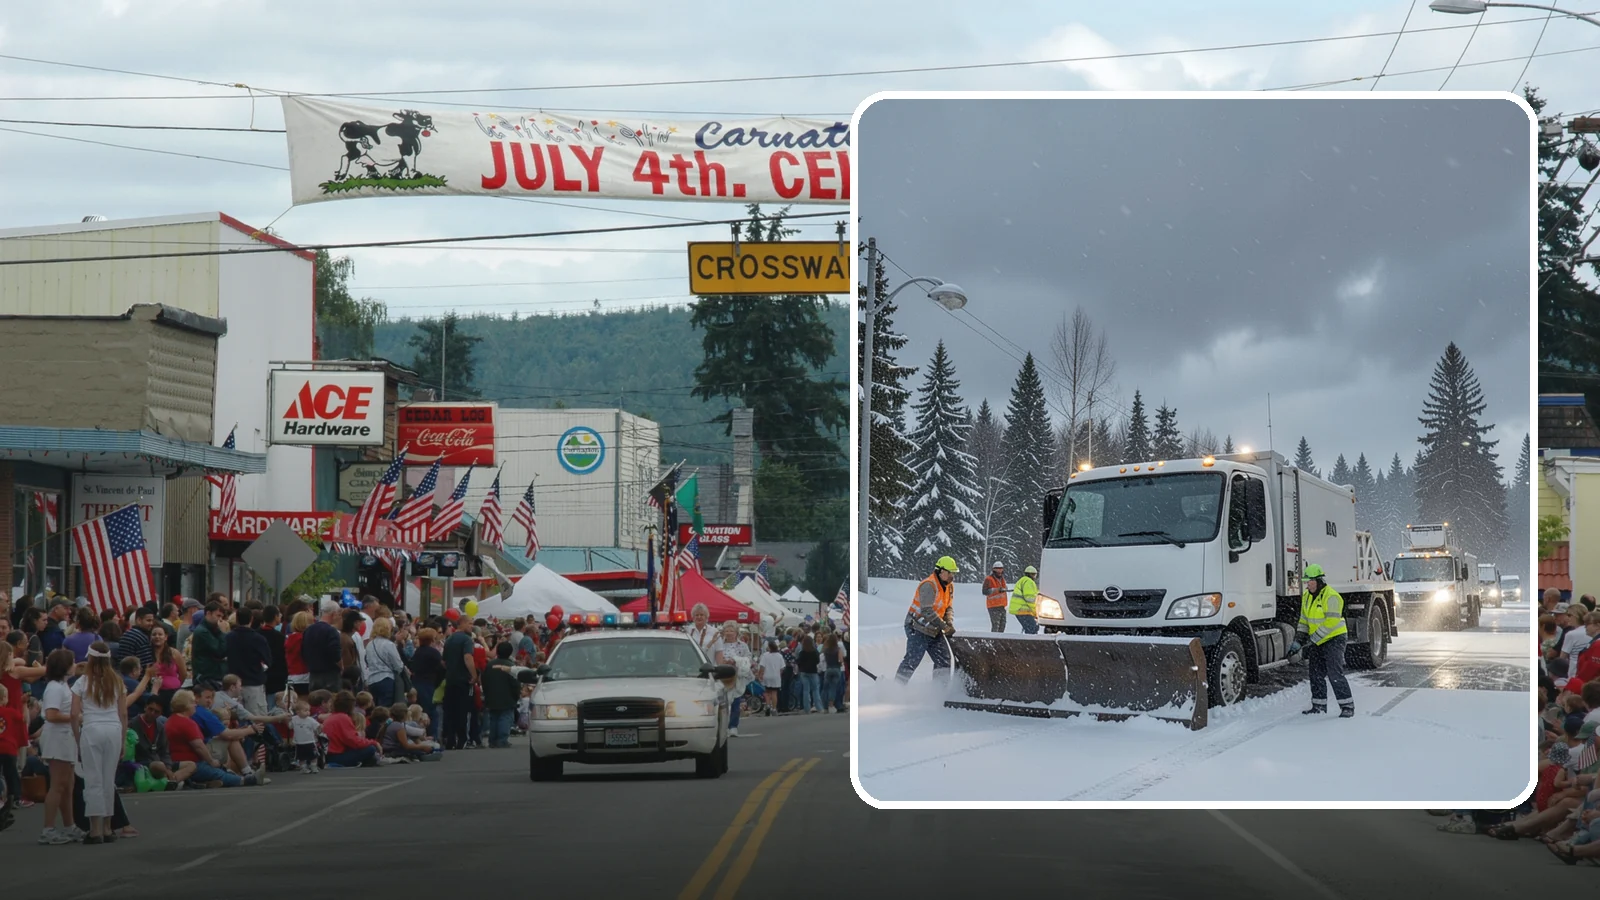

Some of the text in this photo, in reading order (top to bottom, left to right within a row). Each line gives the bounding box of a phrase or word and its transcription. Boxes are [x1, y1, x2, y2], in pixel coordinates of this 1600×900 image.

[481, 140, 605, 192] JULY
[632, 149, 746, 197] 4th.
[697, 254, 850, 280] CROSSWA
[282, 380, 373, 420] ACE
[406, 409, 452, 422] CEDAR
[283, 421, 370, 436] Hardware
[416, 428, 477, 447] Coca-Cola
[353, 467, 385, 482] Simpl
[96, 485, 124, 495] Vincent
[126, 486, 135, 495] de
[137, 486, 155, 495] Paul
[212, 516, 331, 536] HARDARE
[688, 526, 741, 535] CRNATION
[699, 535, 730, 543] GLASS
